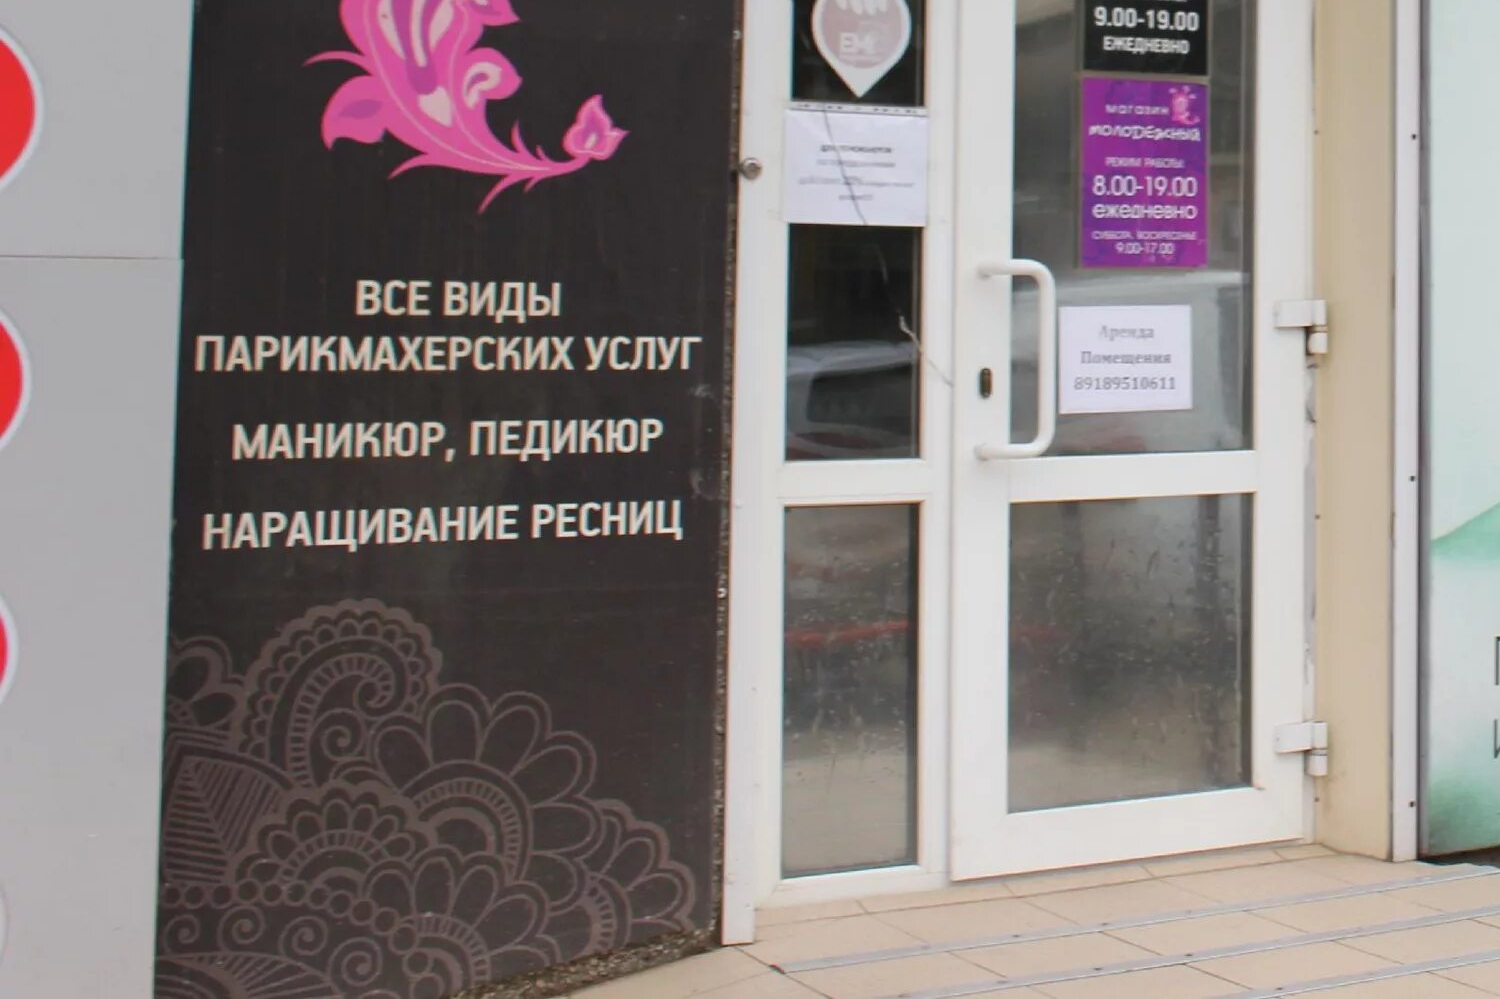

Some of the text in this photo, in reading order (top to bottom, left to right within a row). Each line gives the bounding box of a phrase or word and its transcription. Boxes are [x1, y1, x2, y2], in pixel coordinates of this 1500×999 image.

[1094, 6, 1199, 31] 9.00-19.00
[1103, 36, 1190, 54] ЕЖЕДНЕВНО
[1092, 175, 1198, 197] 8.00-19.00
[1092, 204, 1198, 219] ежедневно
[356, 280, 562, 324] ВСЕ ВИДЫ
[1099, 325, 1155, 341] Аренда
[194, 334, 703, 372] ПАРИКМАХЕРСКИХ УСЛУГ
[1081, 351, 1171, 364] Помещения
[1074, 376, 1176, 391] 89189510611
[231, 418, 664, 462] МАНИКЮР, ПЕДИКЮР
[202, 500, 684, 553] НАРАЩИВАНИЕ РЕСНИЦ
